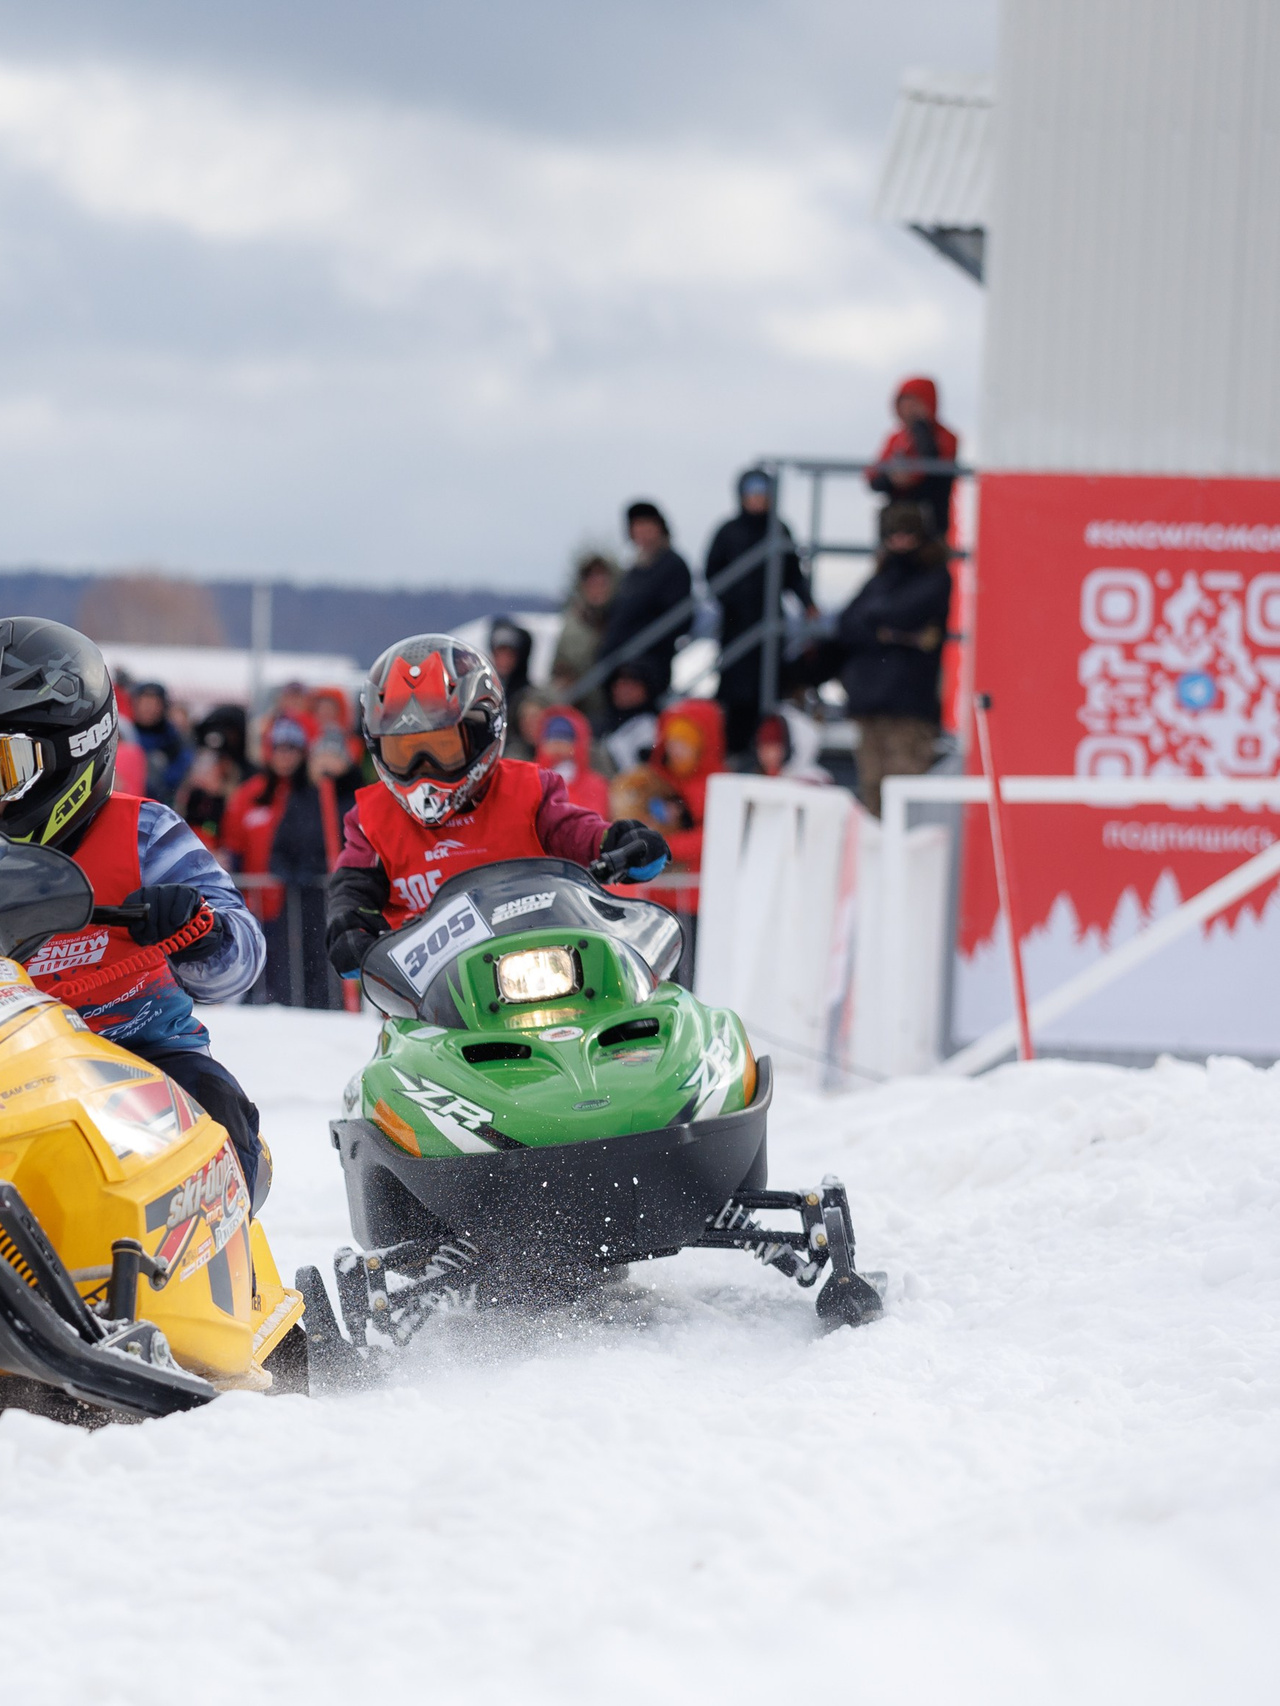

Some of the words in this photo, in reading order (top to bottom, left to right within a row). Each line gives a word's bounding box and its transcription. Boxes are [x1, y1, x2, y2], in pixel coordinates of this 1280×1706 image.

[68, 711, 113, 758] 509
[393, 869, 445, 912] 305
[30, 930, 109, 963] SNOW
[404, 906, 476, 978] 305
[82, 979, 145, 1020] COMPOSIT
[391, 1073, 495, 1131] ZR
